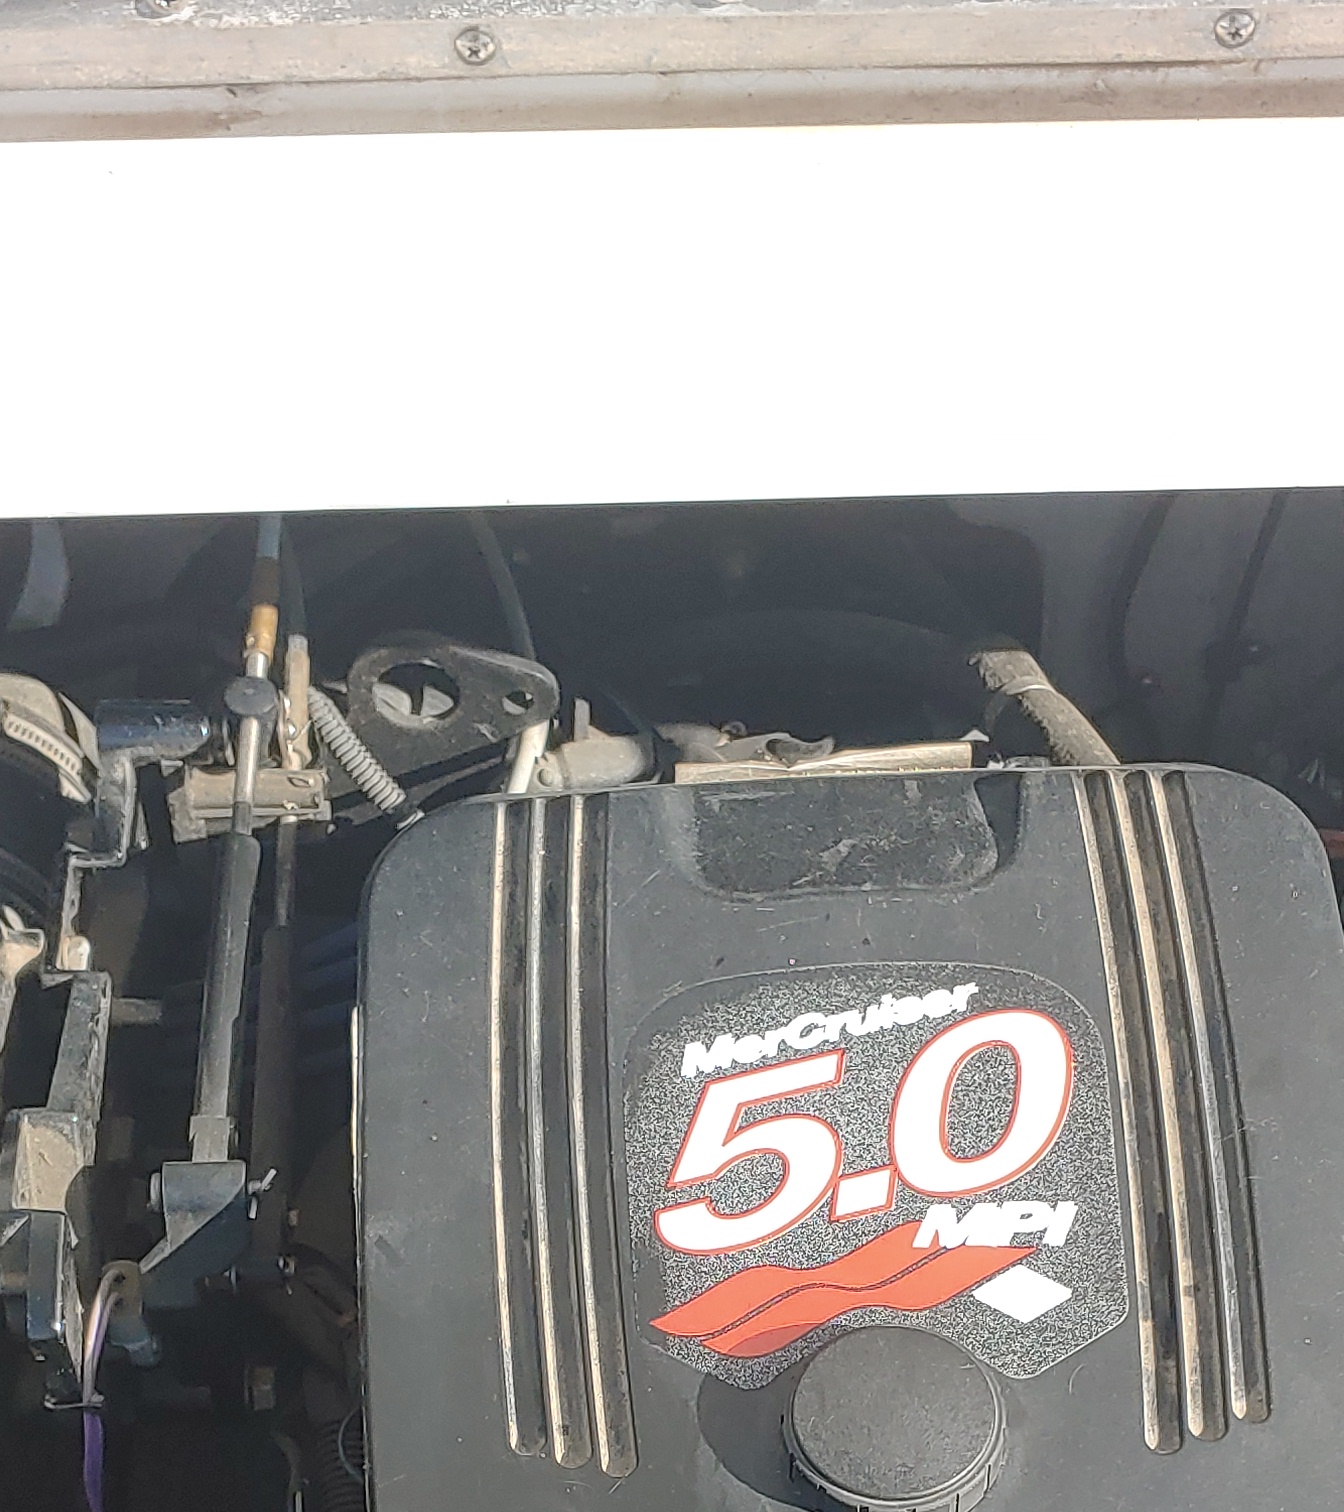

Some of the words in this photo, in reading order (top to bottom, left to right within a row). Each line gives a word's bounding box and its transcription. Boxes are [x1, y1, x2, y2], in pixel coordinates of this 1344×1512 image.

[680, 981, 979, 1078] MerCruiser
[655, 1008, 1074, 1256] 5.0
[911, 1200, 1078, 1249] MPI
